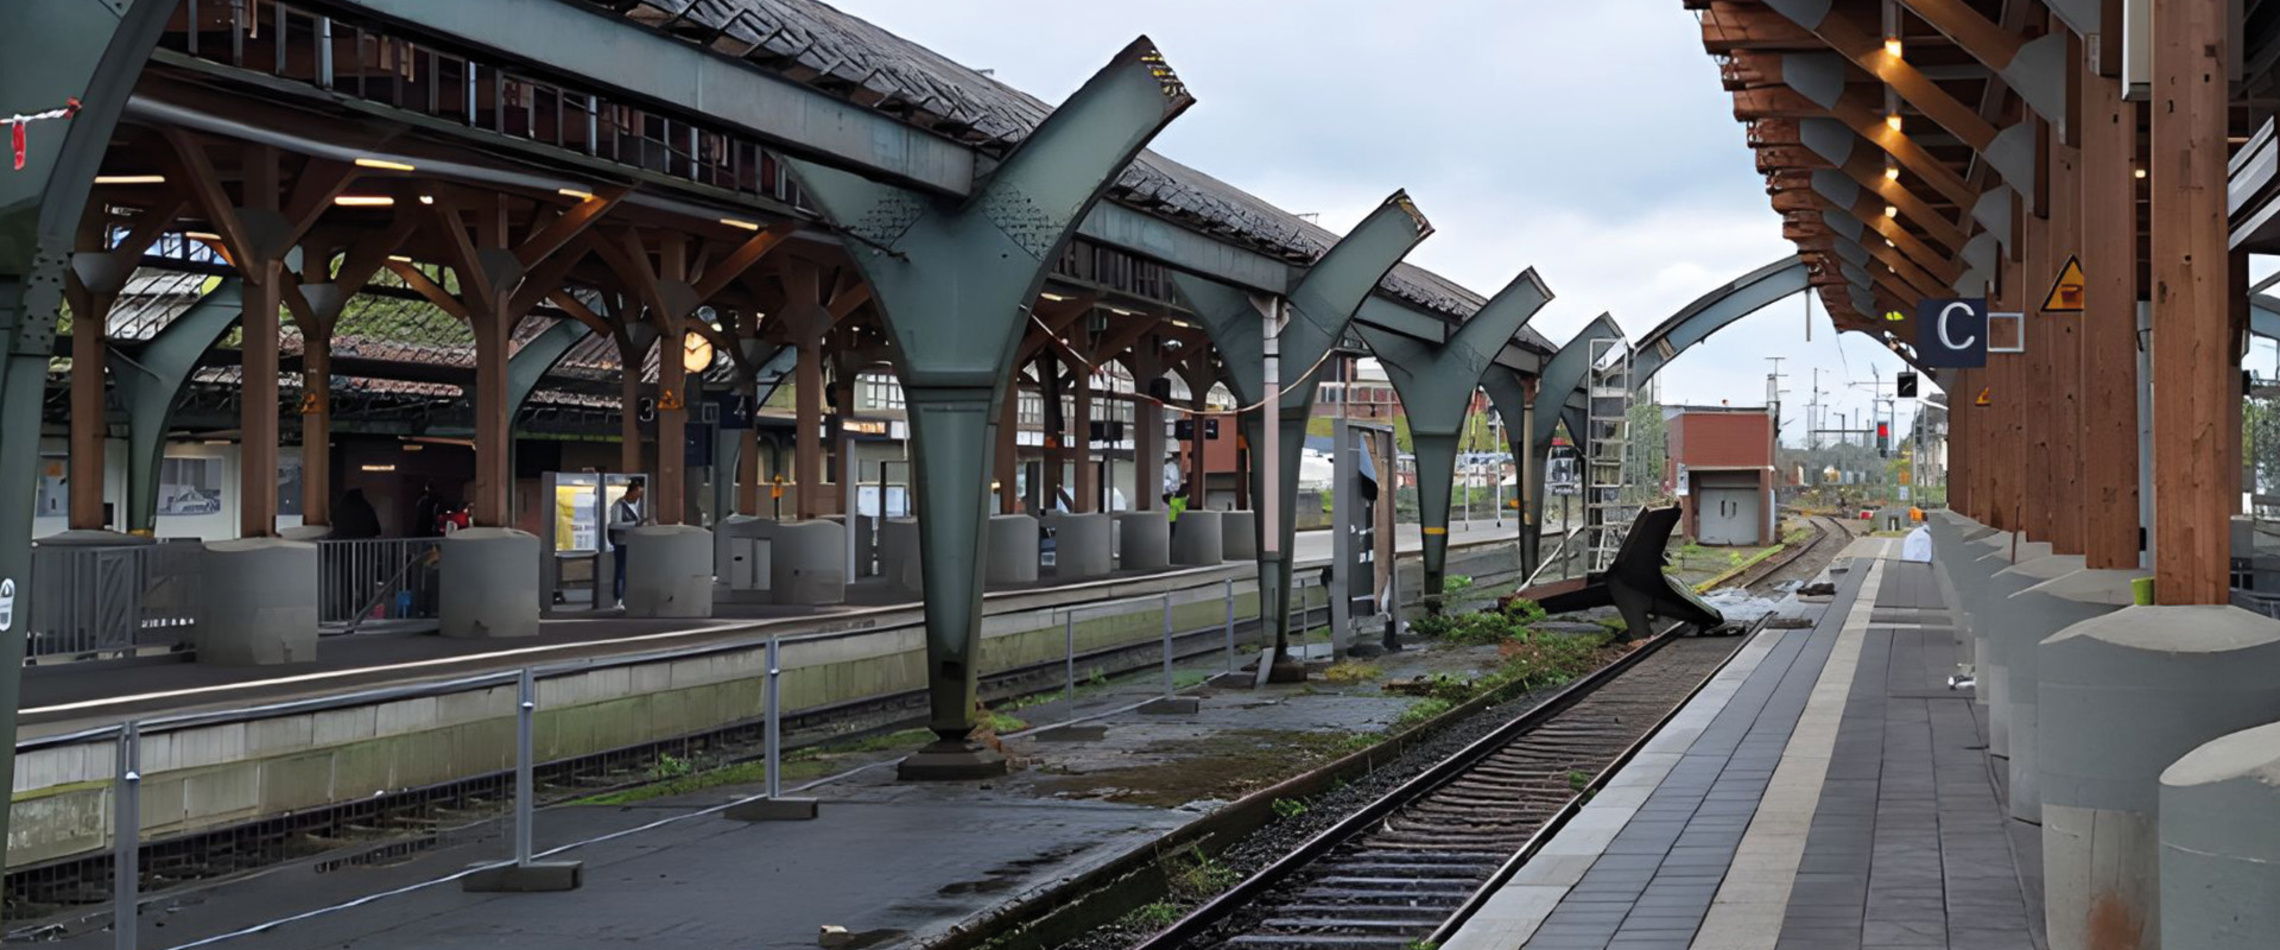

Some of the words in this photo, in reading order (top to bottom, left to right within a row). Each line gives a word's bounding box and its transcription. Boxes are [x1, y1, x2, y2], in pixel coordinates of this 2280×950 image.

[1937, 301, 1975, 350] C
[639, 396, 654, 422] 3
[733, 394, 746, 421] 4
